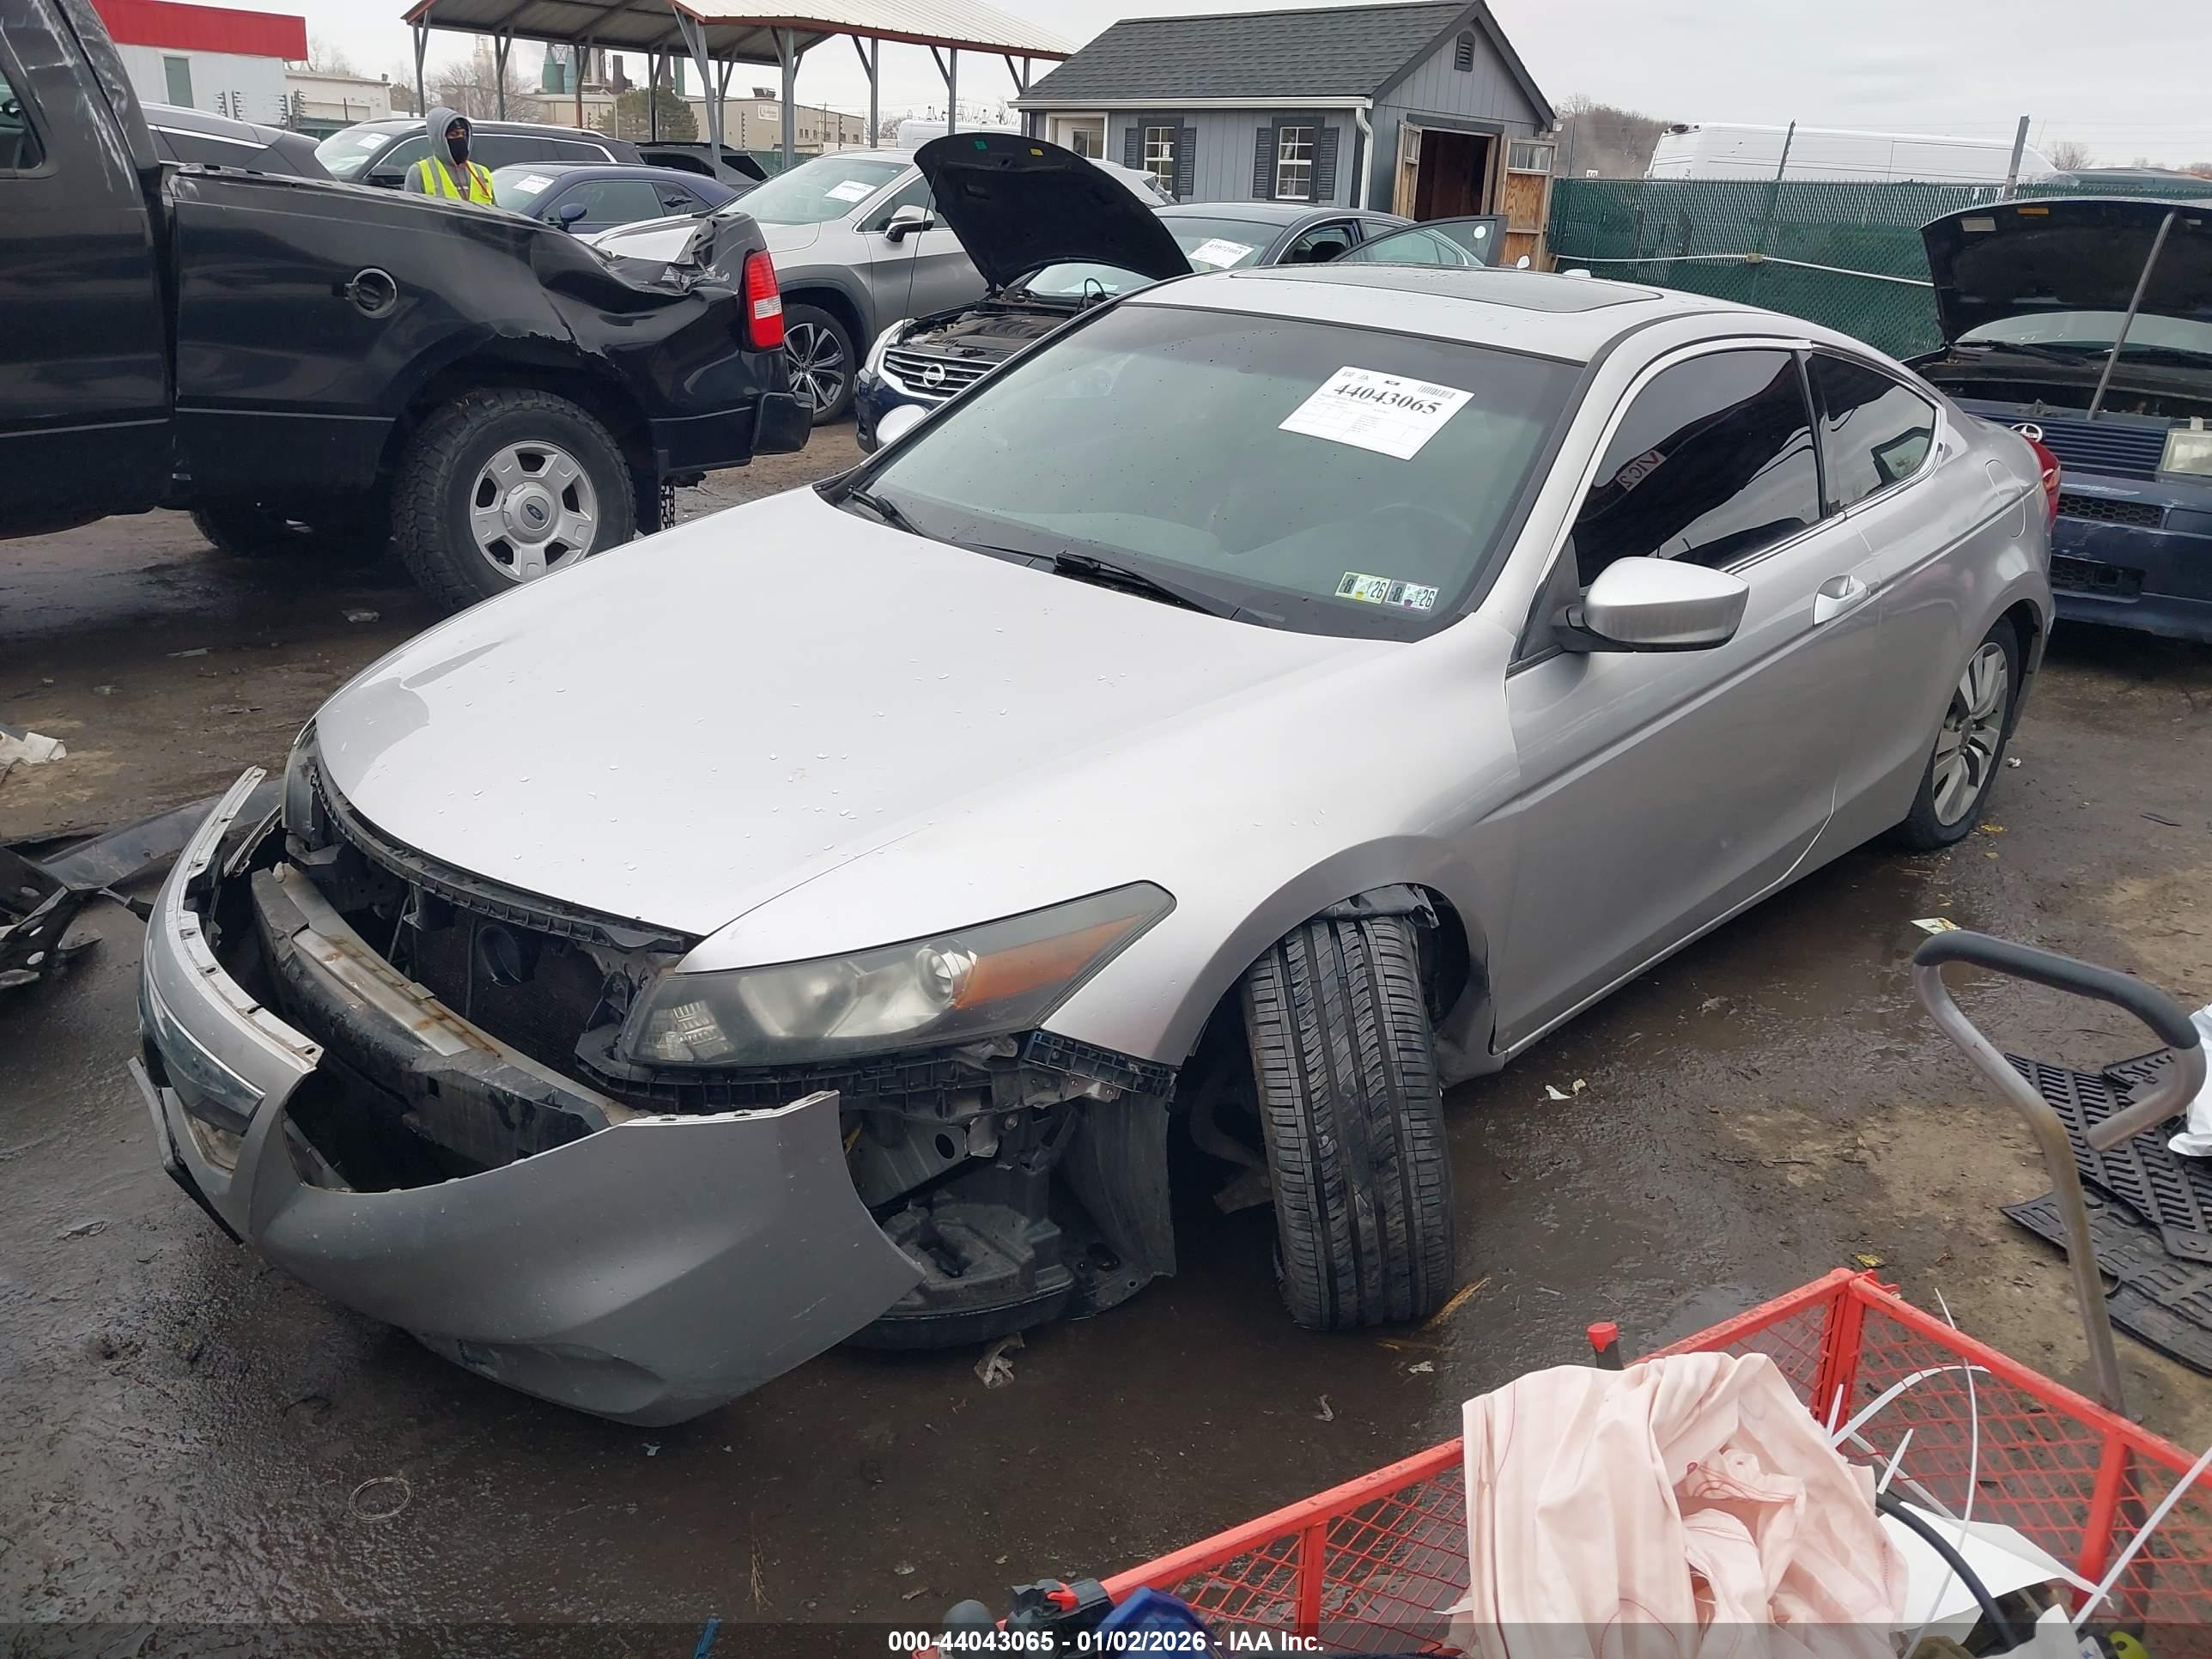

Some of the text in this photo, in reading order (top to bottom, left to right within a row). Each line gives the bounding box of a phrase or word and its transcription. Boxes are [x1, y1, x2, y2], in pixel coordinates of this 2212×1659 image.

[1334, 383, 1443, 415] 44043065
[1370, 580, 1387, 599] 26
[1419, 589, 1435, 608] 26
